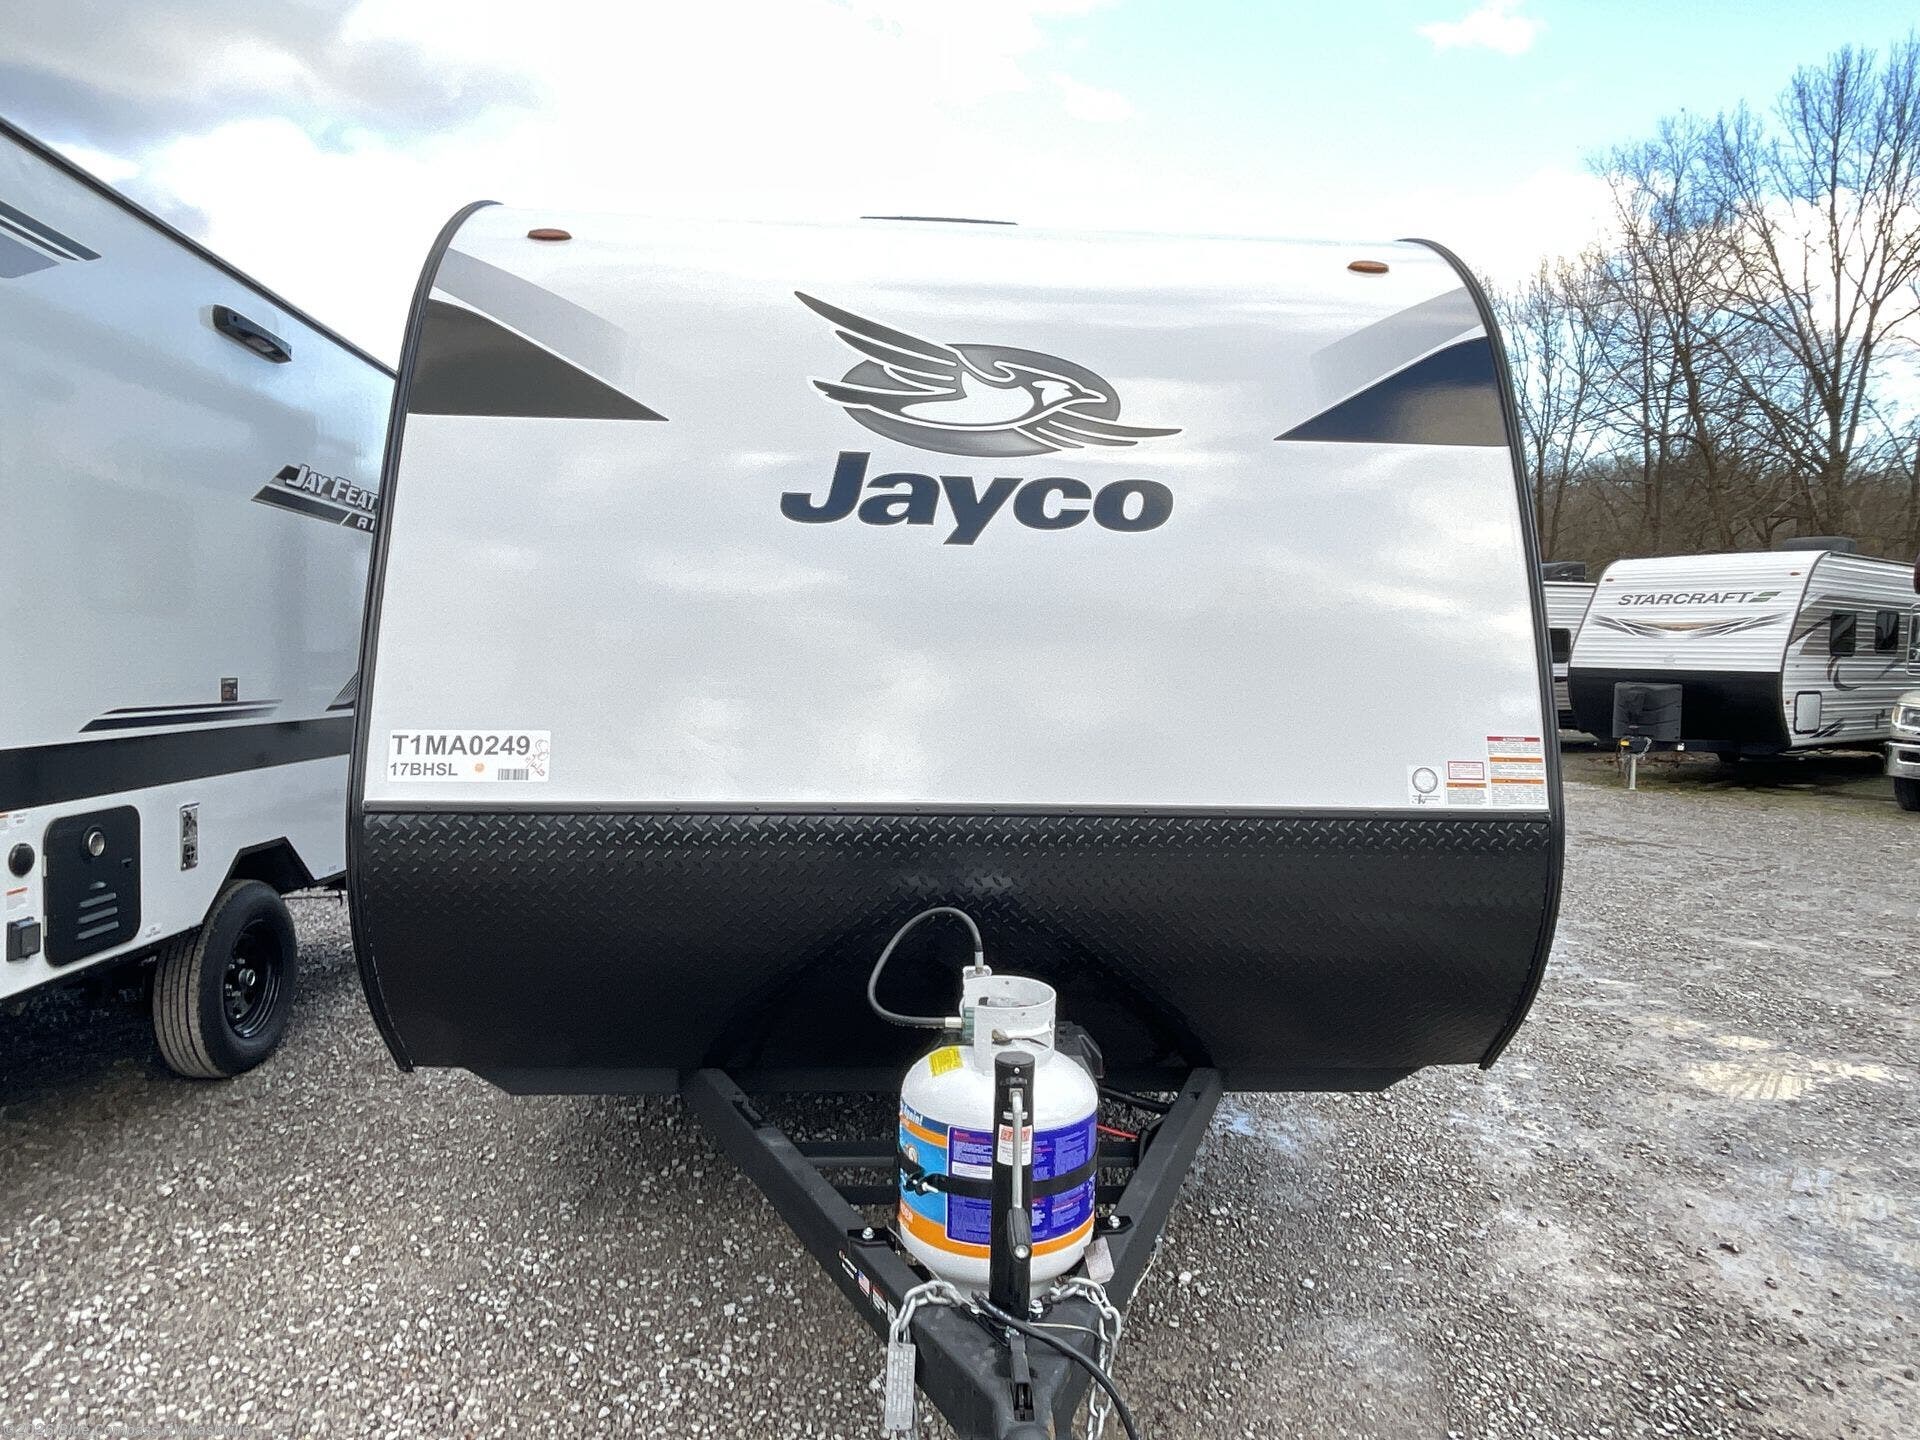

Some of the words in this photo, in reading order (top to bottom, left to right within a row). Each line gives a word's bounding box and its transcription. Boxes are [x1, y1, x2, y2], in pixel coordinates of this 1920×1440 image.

[285, 463, 331, 495] JAY
[780, 450, 1174, 546] Jayco
[1618, 591, 1753, 606] STARCRAFT
[392, 734, 531, 756] T1MA0249
[390, 762, 458, 777] 17BHSL
